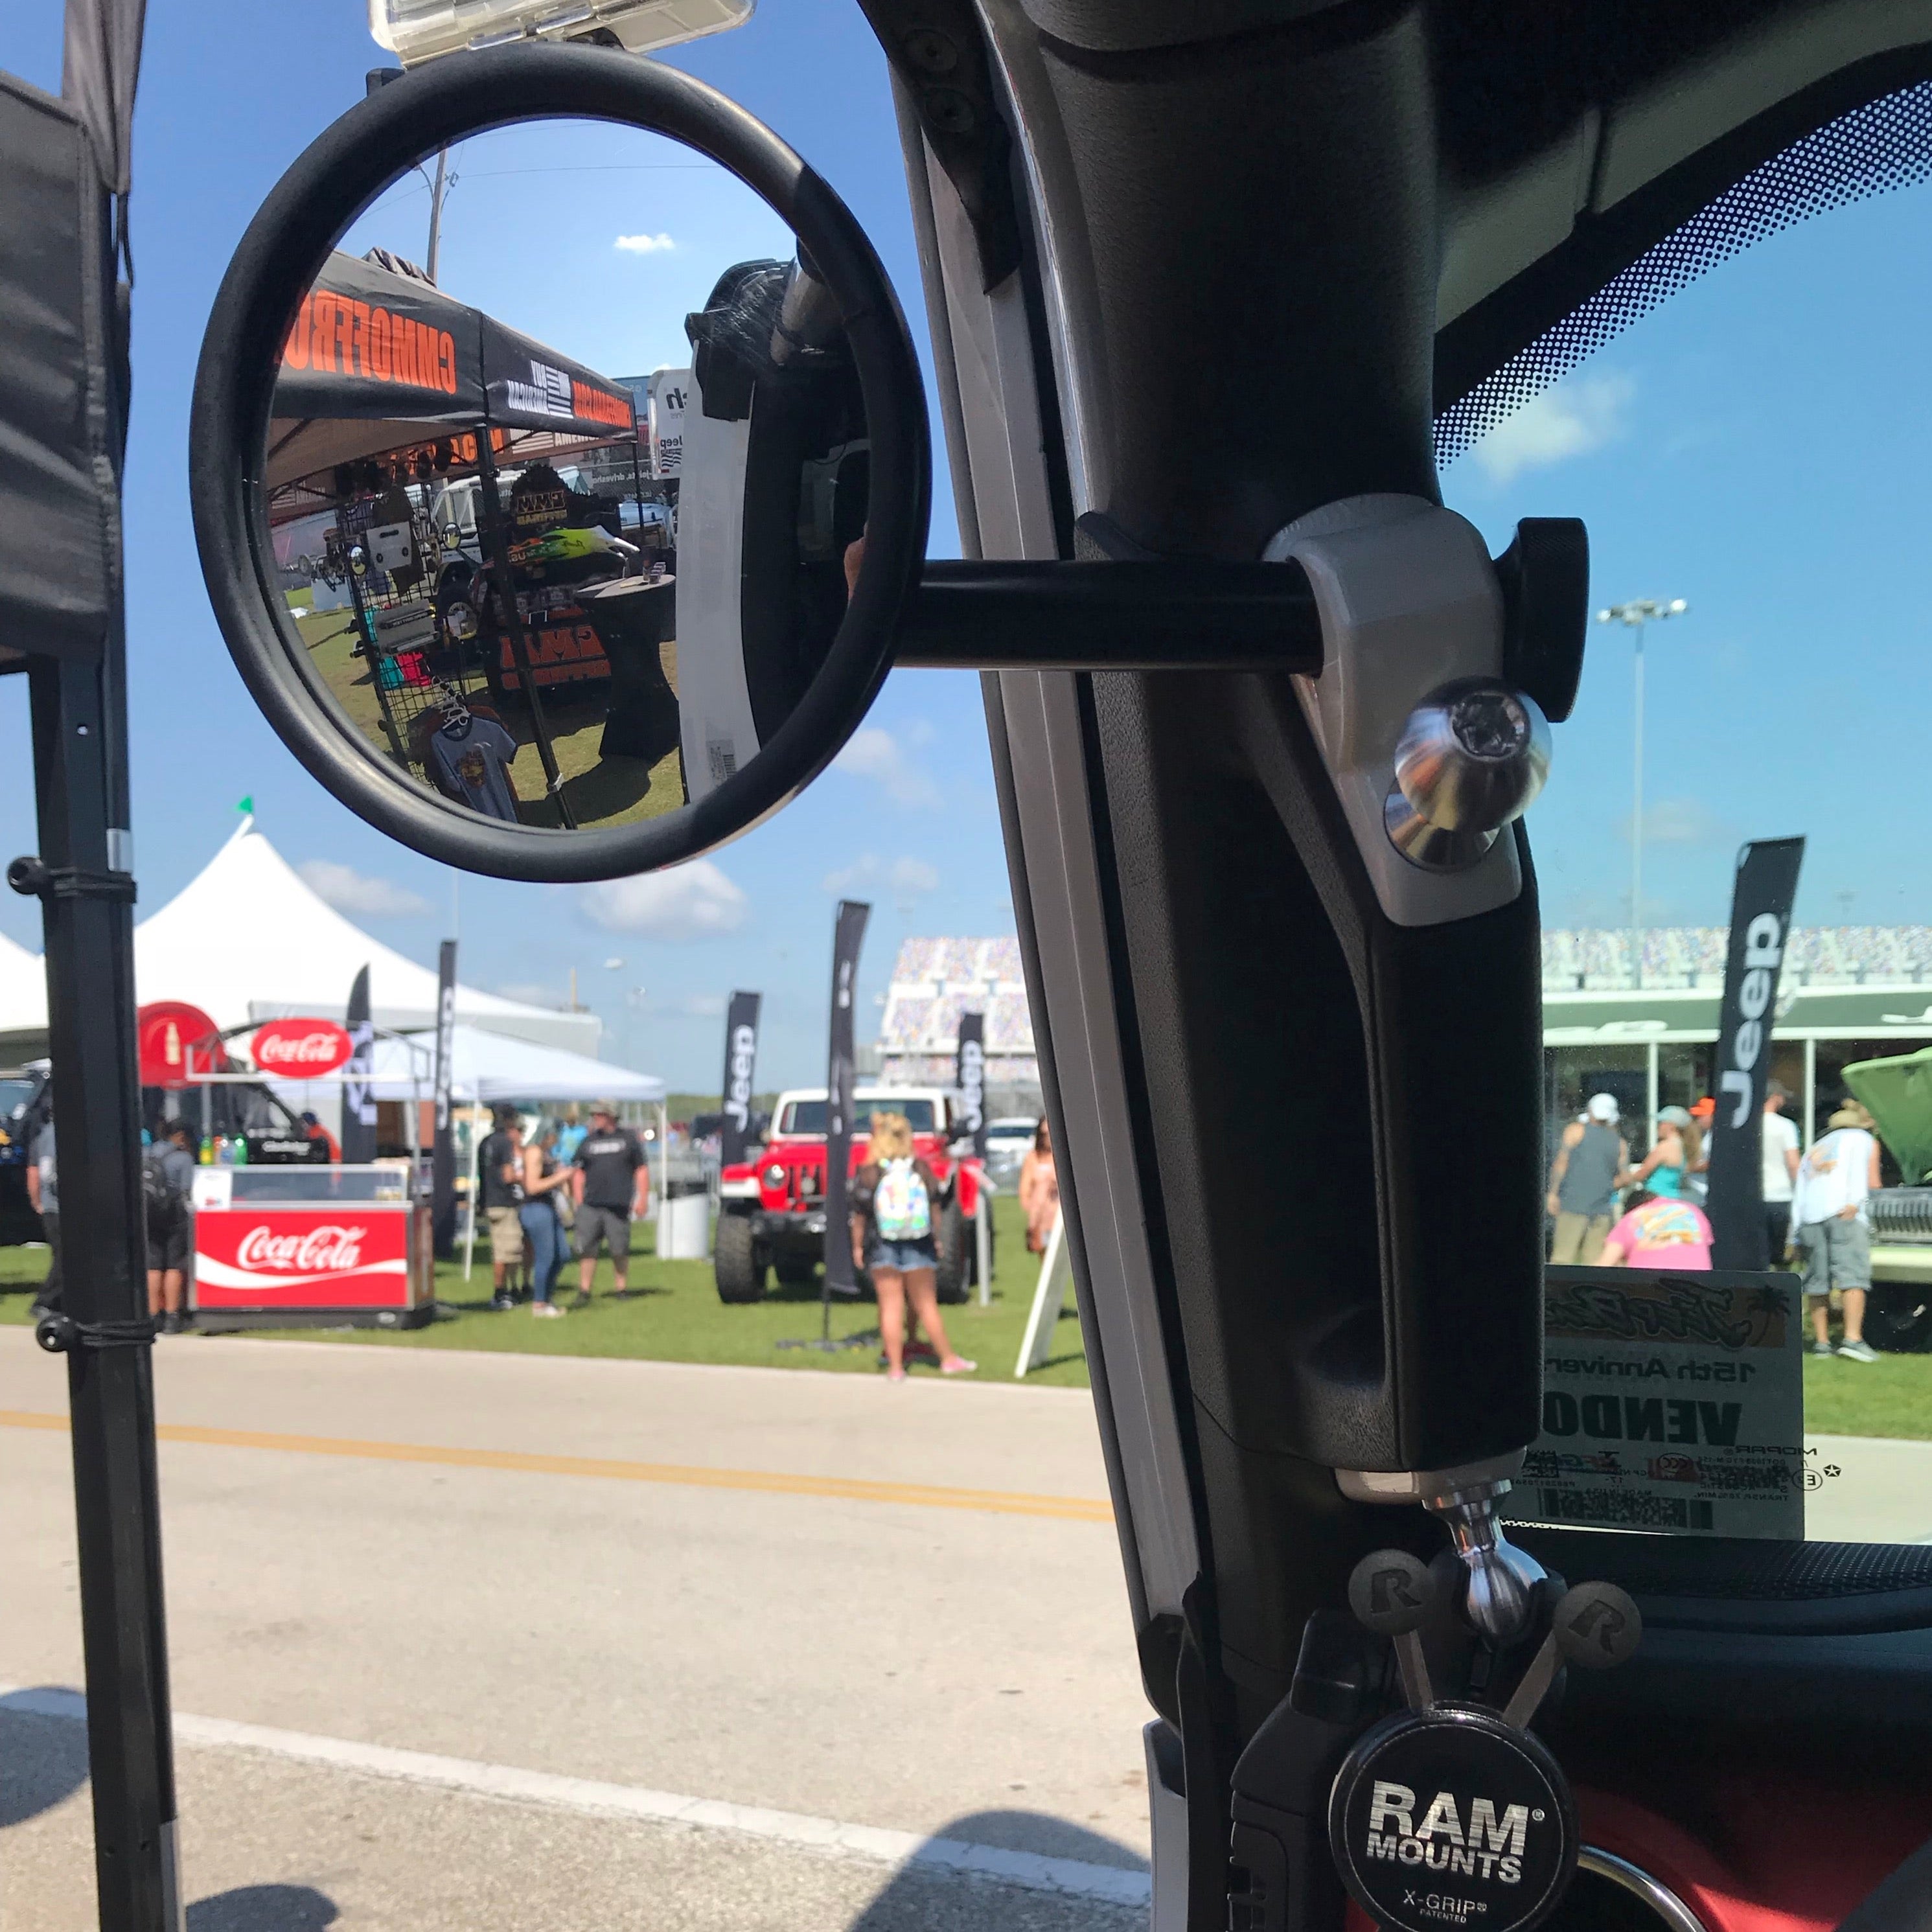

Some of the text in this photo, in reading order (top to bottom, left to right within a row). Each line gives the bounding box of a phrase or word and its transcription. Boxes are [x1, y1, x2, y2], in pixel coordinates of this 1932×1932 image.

[1721, 912, 1784, 1129] Jeep
[724, 1023, 755, 1134] Jeep
[238, 1225, 367, 1270] Coca-Cola
[1371, 1568, 1422, 1615] R
[1366, 1831, 1523, 1884] MOUNTS
[1419, 1909, 1467, 1924] PATENTED
